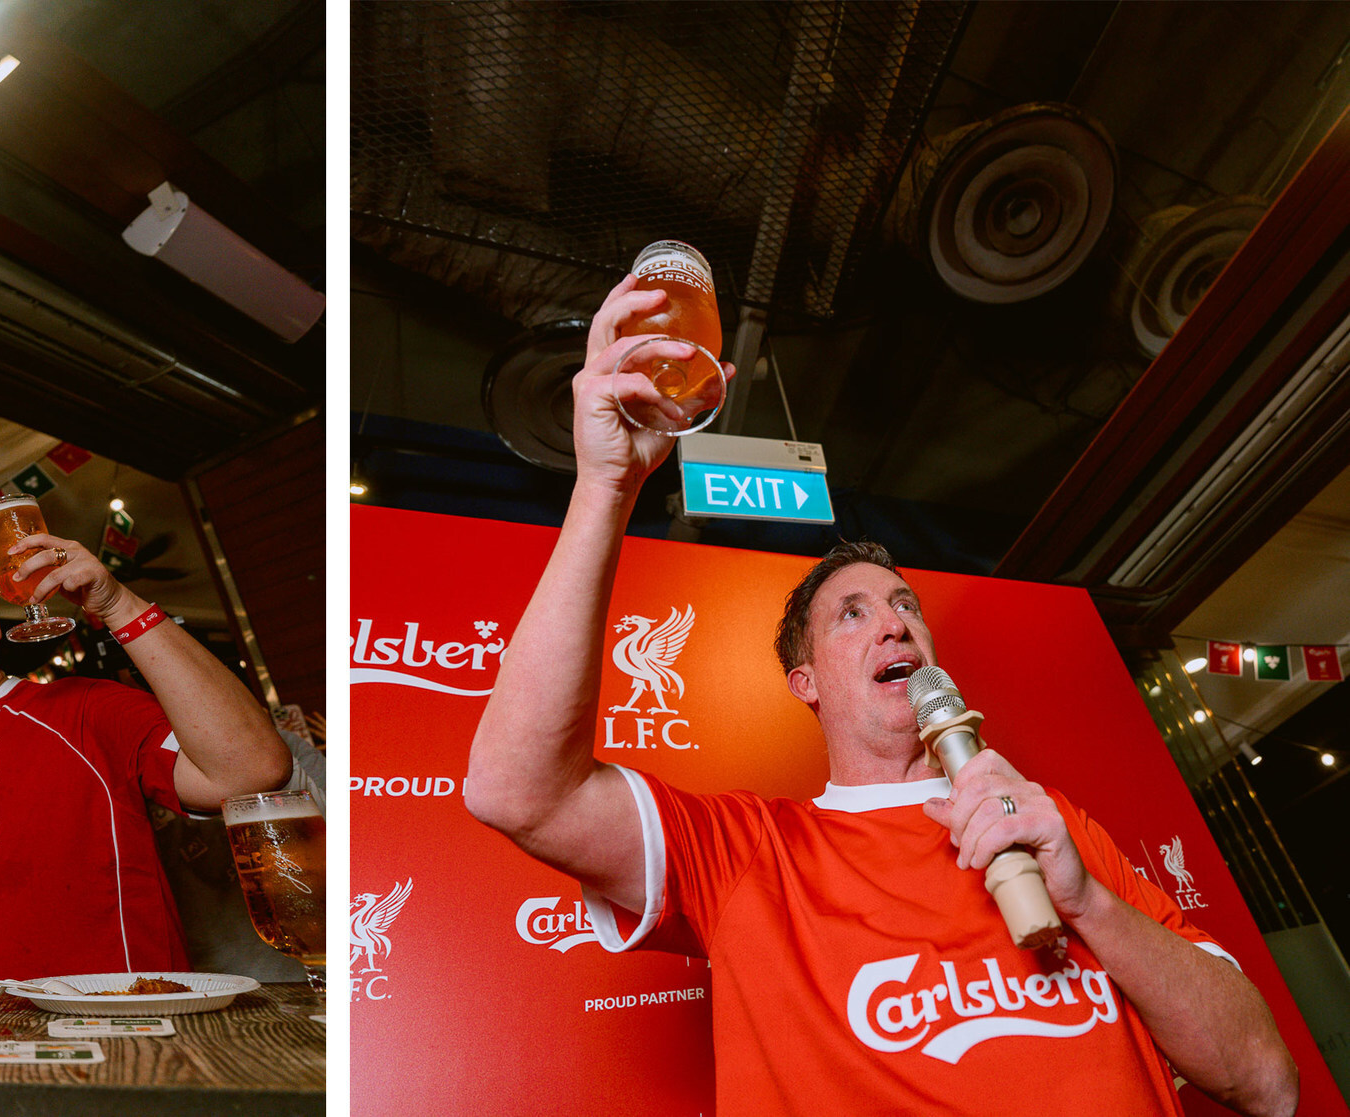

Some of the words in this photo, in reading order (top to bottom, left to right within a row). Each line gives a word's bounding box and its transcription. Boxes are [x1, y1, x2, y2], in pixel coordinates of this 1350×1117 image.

[704, 473, 784, 510] EXIT
[350, 618, 508, 671] lsber
[603, 717, 699, 750] L.F.C.
[585, 995, 638, 1012] PROUD
[640, 987, 705, 1006] PARTNER
[847, 954, 1119, 1053] Carlsberg
